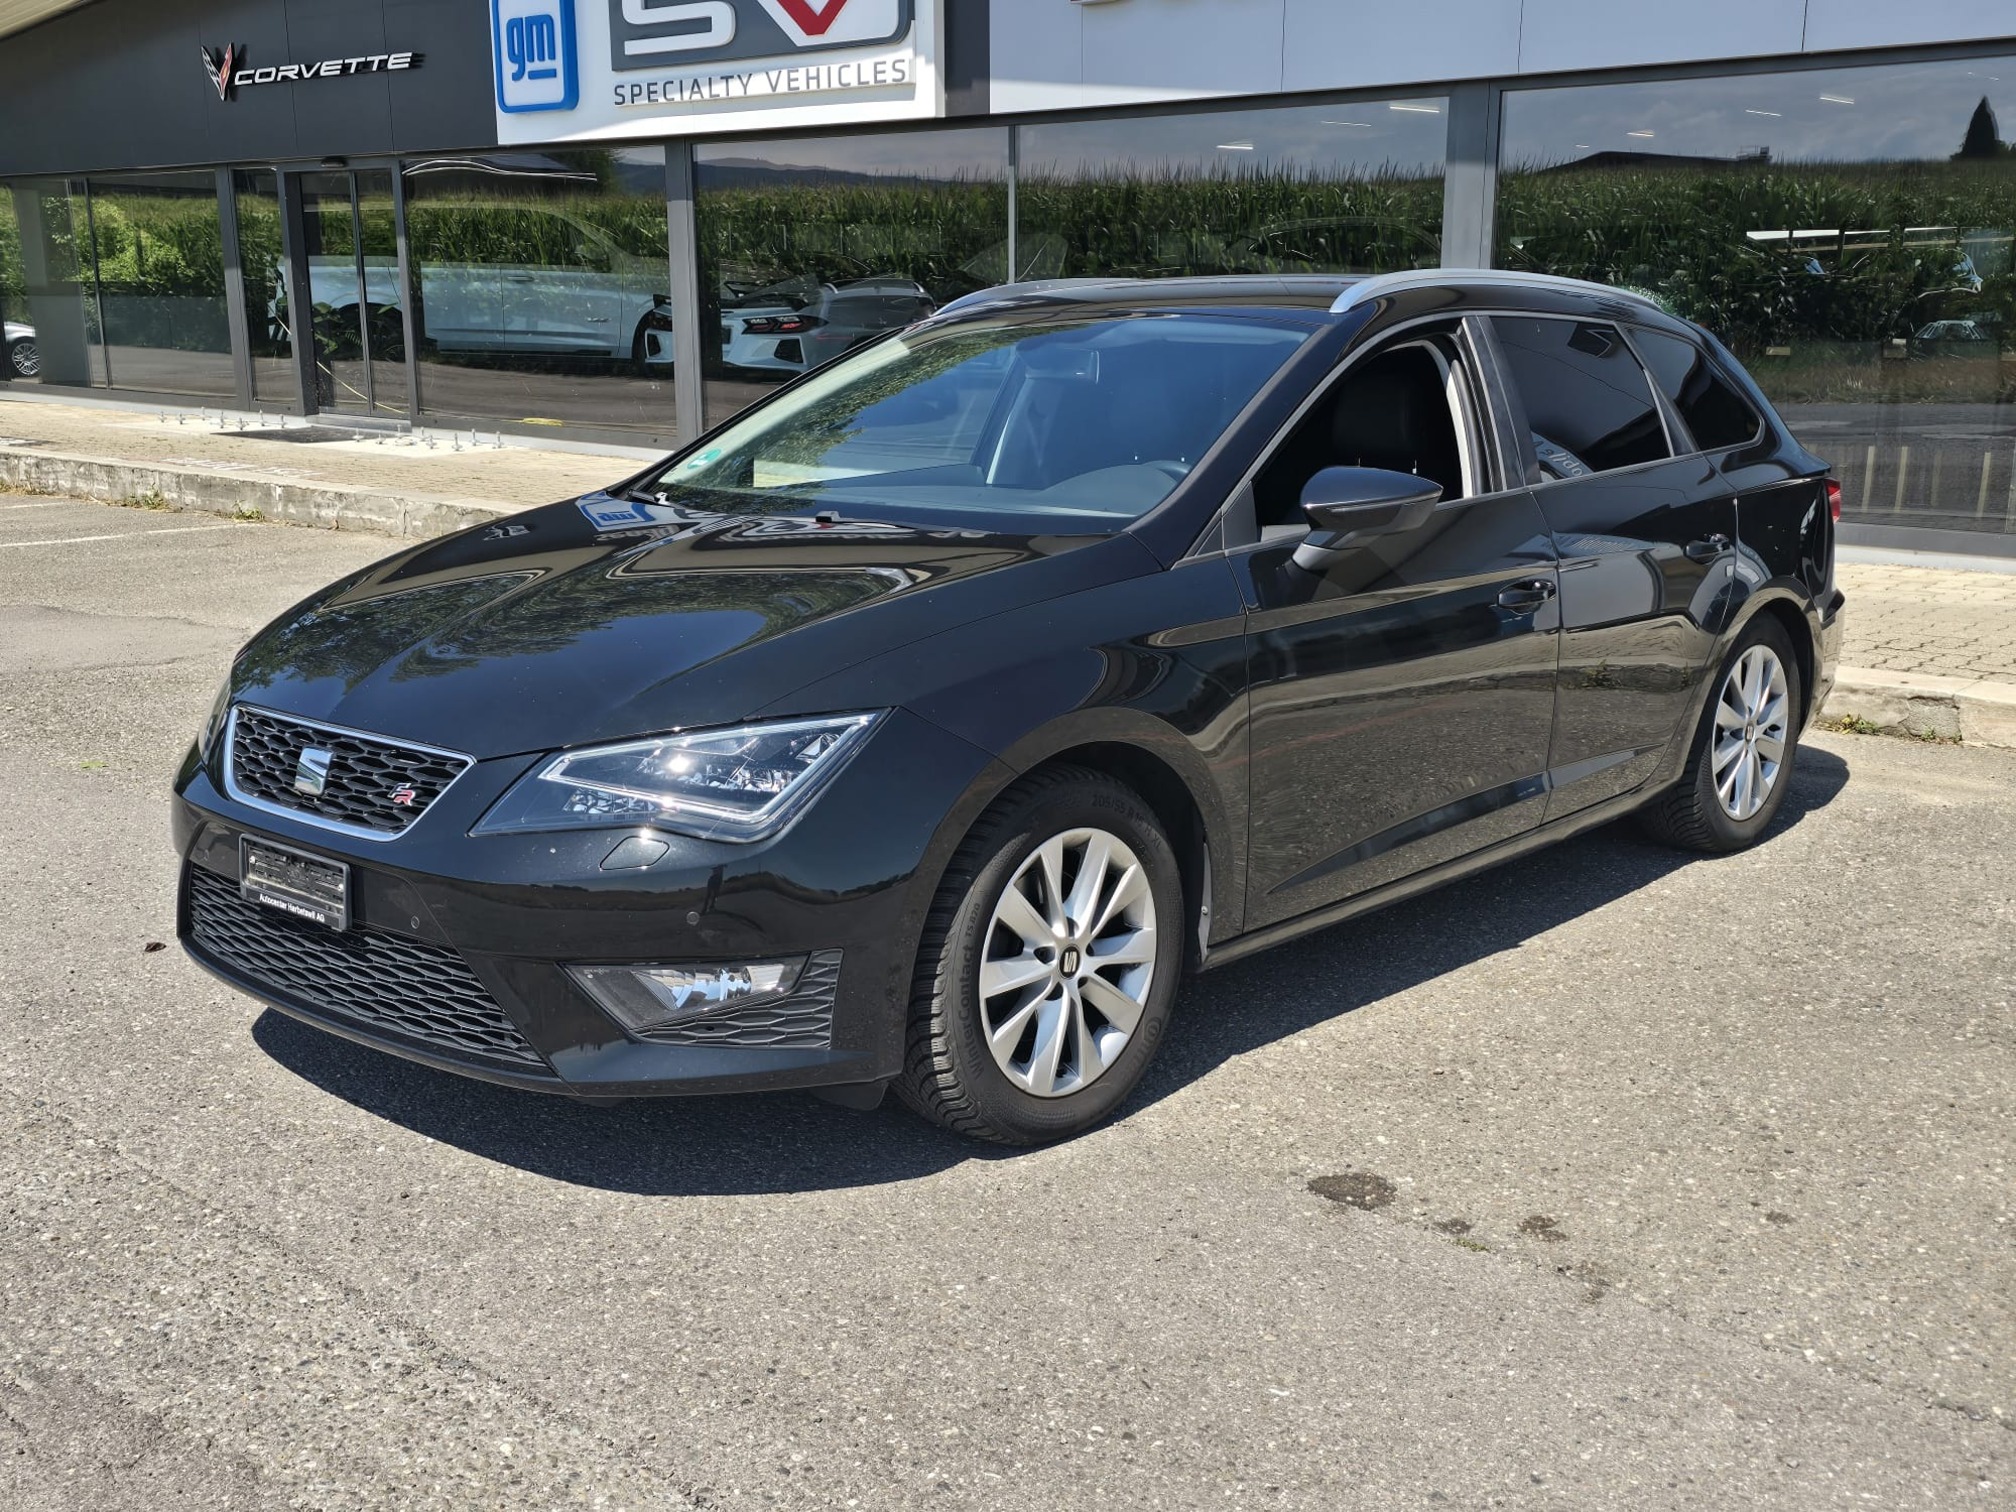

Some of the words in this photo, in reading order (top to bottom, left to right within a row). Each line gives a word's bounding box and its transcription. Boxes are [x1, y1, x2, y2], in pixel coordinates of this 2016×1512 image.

[234, 52, 413, 86] CORVETTE
[506, 14, 557, 81] gm
[613, 73, 753, 106] SPECIALTY
[765, 59, 907, 93] VEHICLES
[957, 944, 987, 1081] WinterContact
